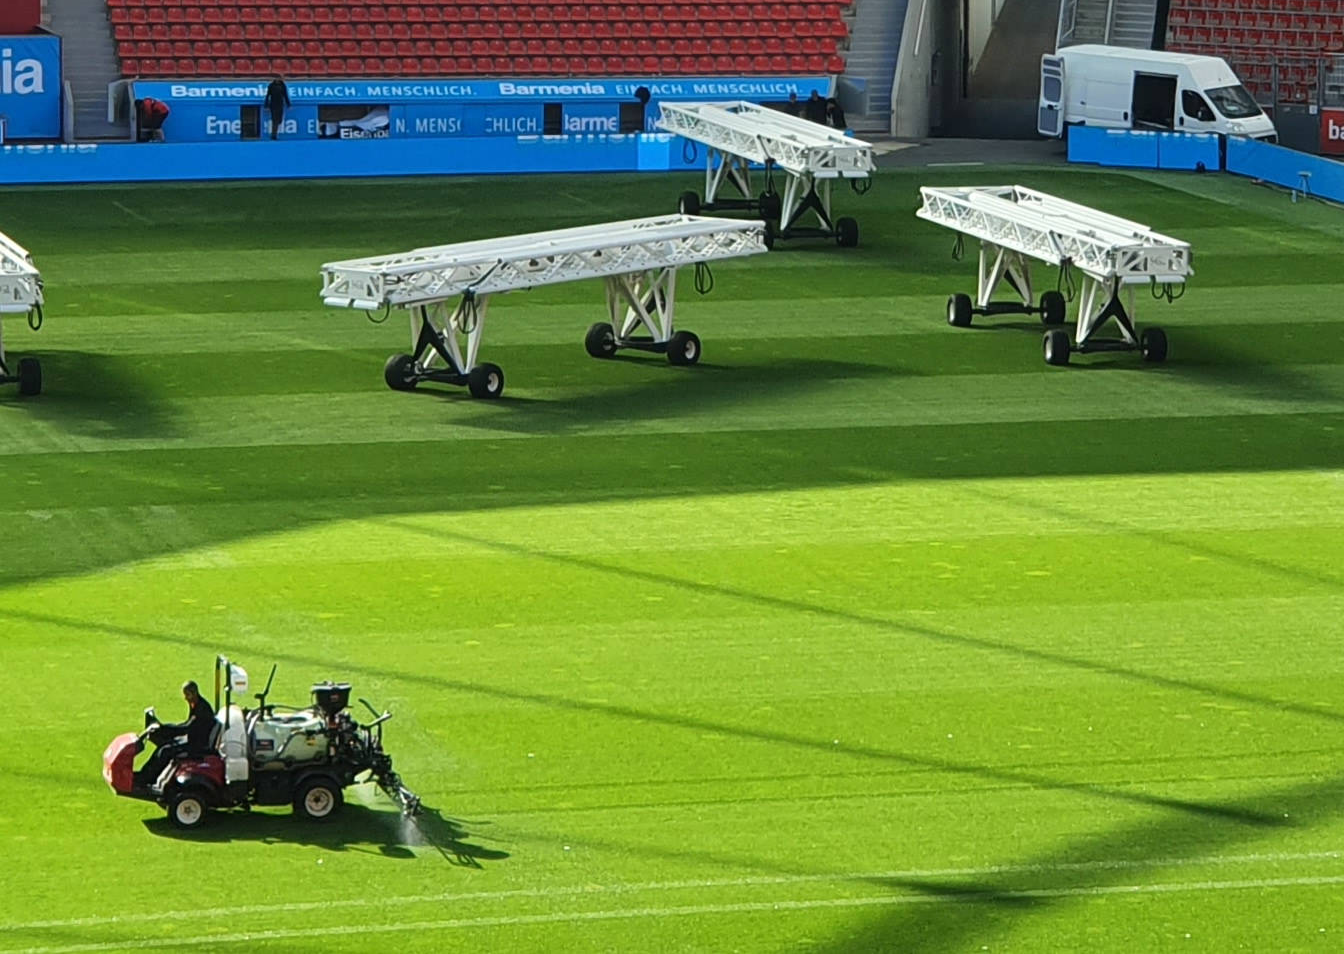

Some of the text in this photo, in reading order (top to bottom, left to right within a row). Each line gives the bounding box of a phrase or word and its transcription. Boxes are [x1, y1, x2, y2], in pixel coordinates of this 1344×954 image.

[368, 84, 477, 96] MENSCHLICH.
[499, 82, 605, 95] Barmenia
[694, 84, 803, 95] MENSCHLICH.
